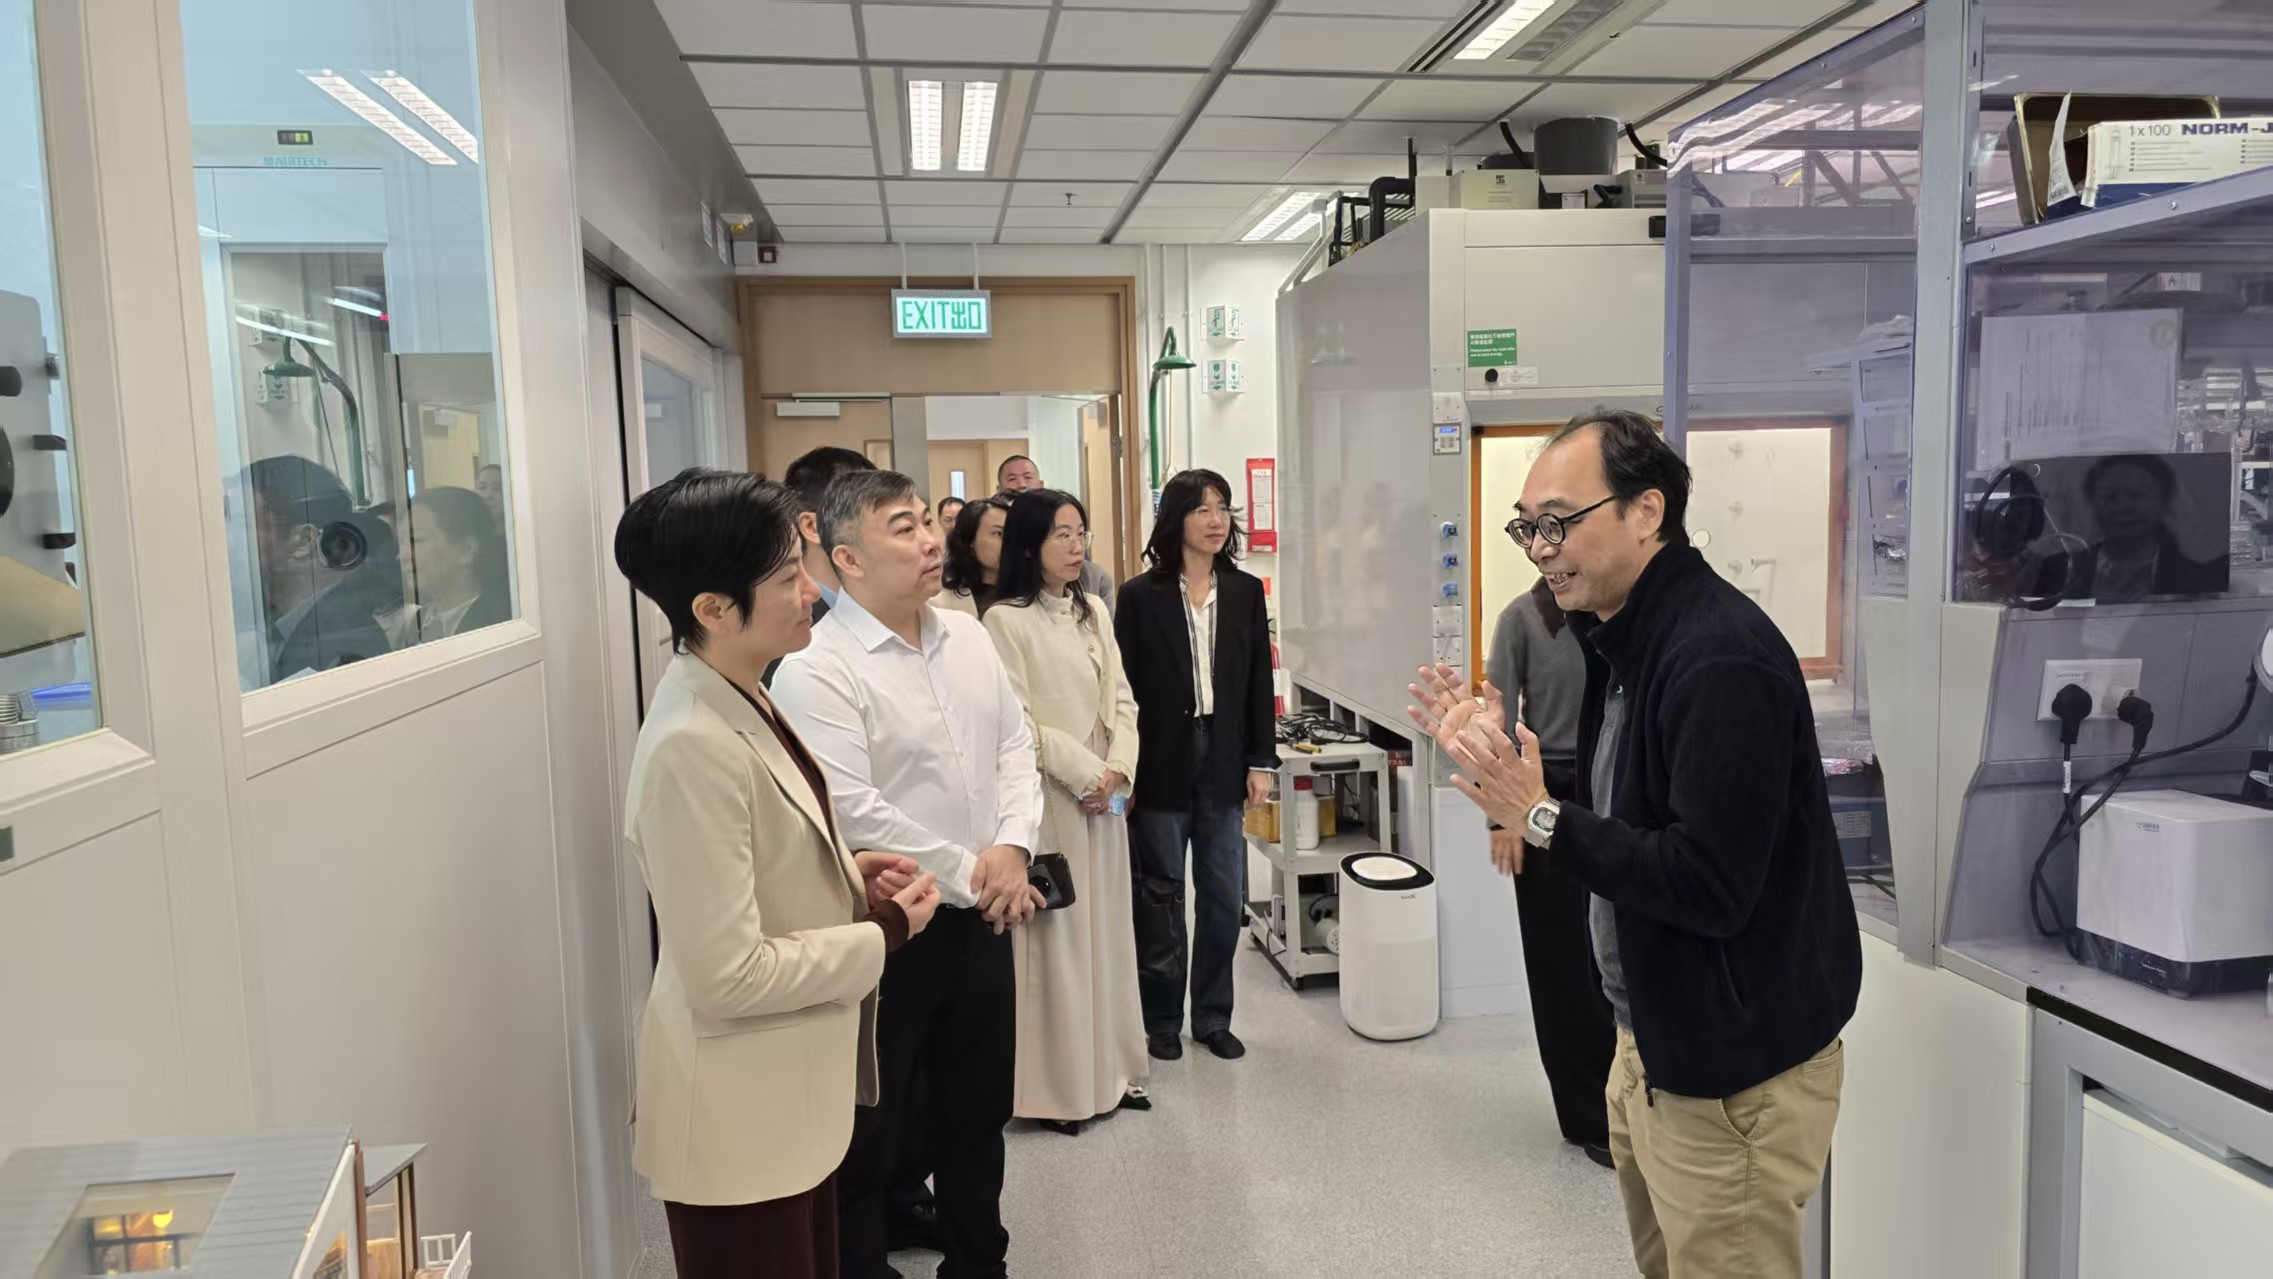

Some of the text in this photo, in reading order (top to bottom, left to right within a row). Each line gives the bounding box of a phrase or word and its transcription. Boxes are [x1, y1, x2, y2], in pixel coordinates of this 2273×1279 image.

[2129, 125, 2135, 137] 1
[2148, 124, 2171, 136] 100
[901, 300, 982, 330] EXIT 出口
